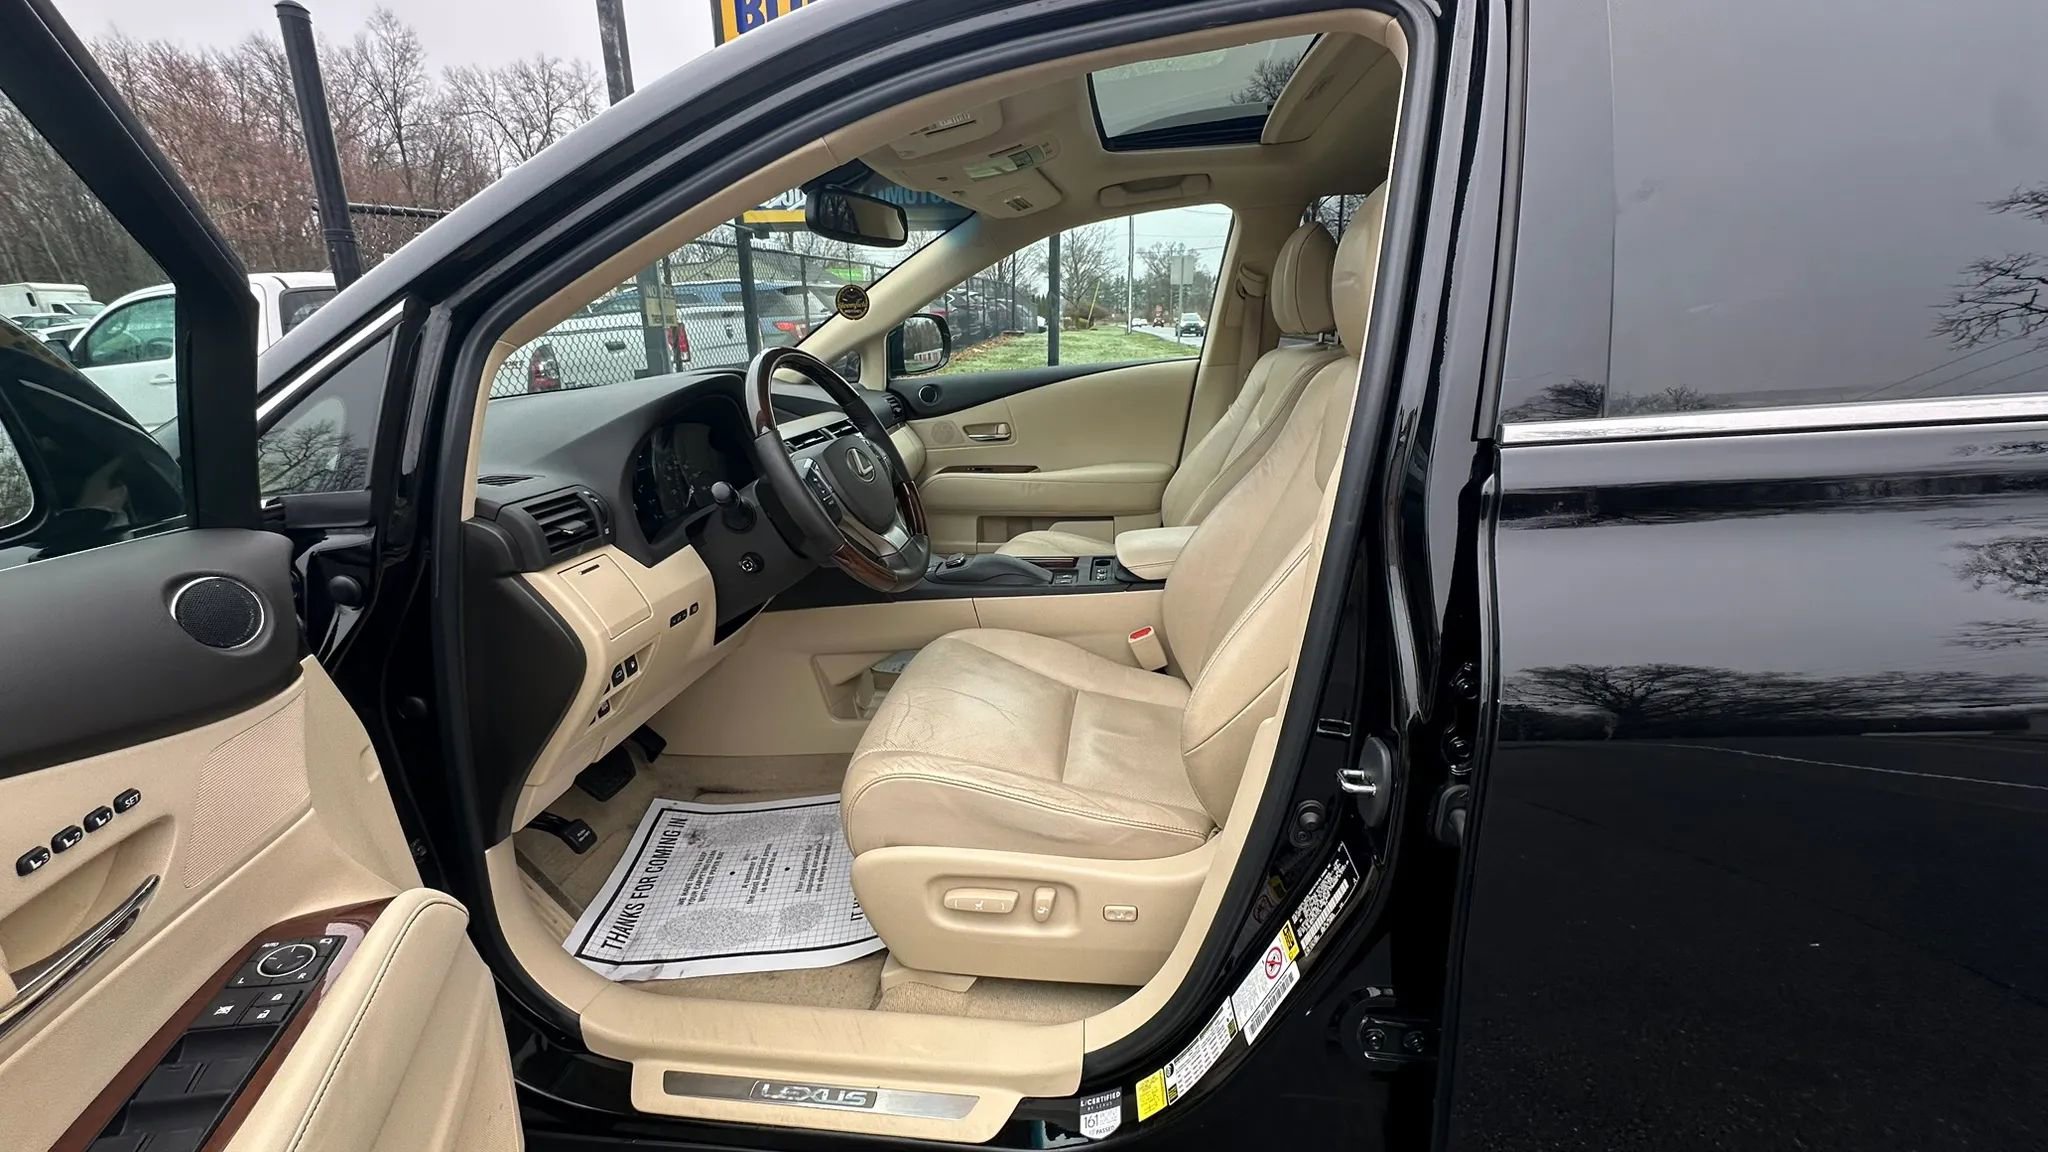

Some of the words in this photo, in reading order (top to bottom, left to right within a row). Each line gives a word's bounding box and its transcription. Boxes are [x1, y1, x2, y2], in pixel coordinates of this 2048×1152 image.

[125, 793, 140, 808] SET
[601, 902, 645, 950] THANKS
[631, 875, 659, 899] FOR
[645, 829, 681, 874] COMING
[667, 817, 688, 828] IN
[761, 1083, 868, 1106] LEXUS
[1084, 1114, 1099, 1129] 161
